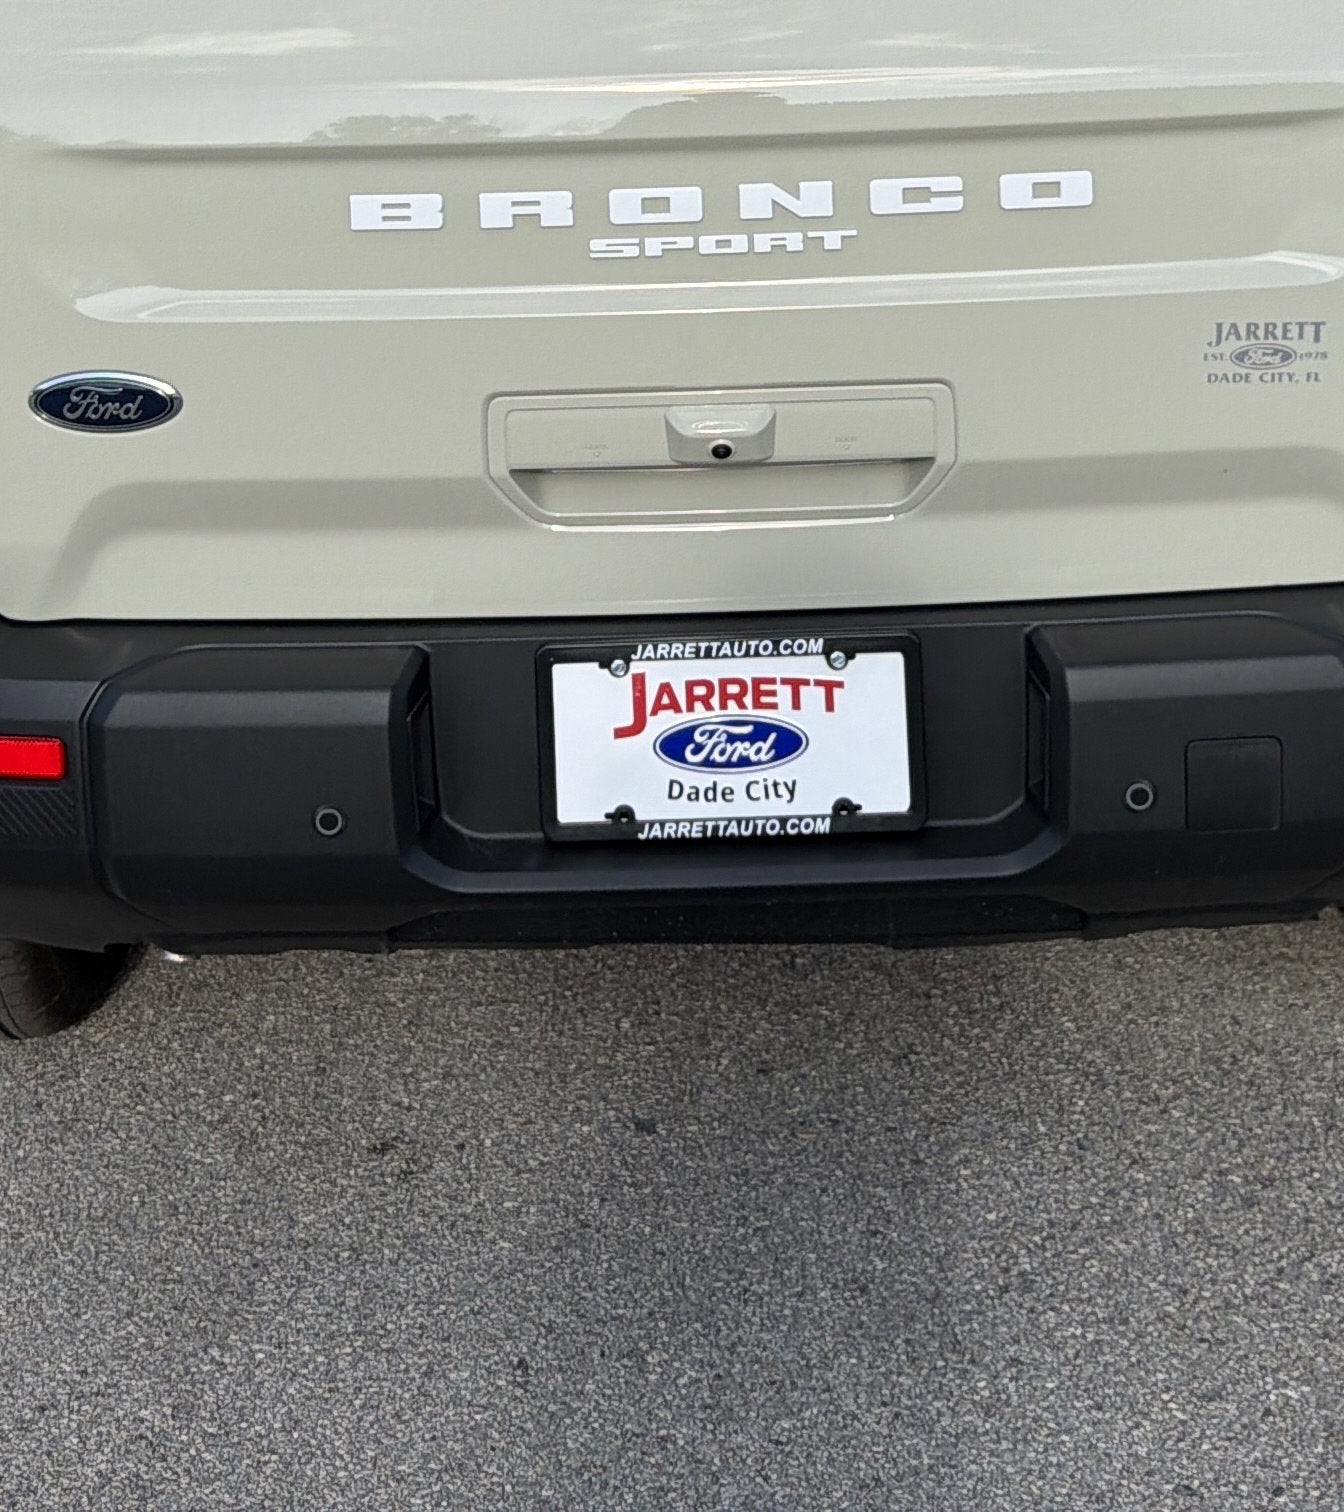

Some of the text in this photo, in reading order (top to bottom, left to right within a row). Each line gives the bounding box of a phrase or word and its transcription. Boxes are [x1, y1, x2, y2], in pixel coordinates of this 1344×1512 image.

[348, 170, 1094, 232] BRONCO
[589, 229, 858, 259] SPORT
[1206, 320, 1327, 348] JARRETT
[1206, 371, 1252, 384] DADE
[1305, 371, 1321, 383] FL
[62, 385, 145, 420] Ford
[630, 637, 825, 661] JARRETTAUTO.COM
[613, 671, 846, 740] JARRETT
[684, 723, 776, 764] Ford
[667, 778, 798, 804] Dade City
[637, 817, 832, 840] JARRETTAUTO.COM
